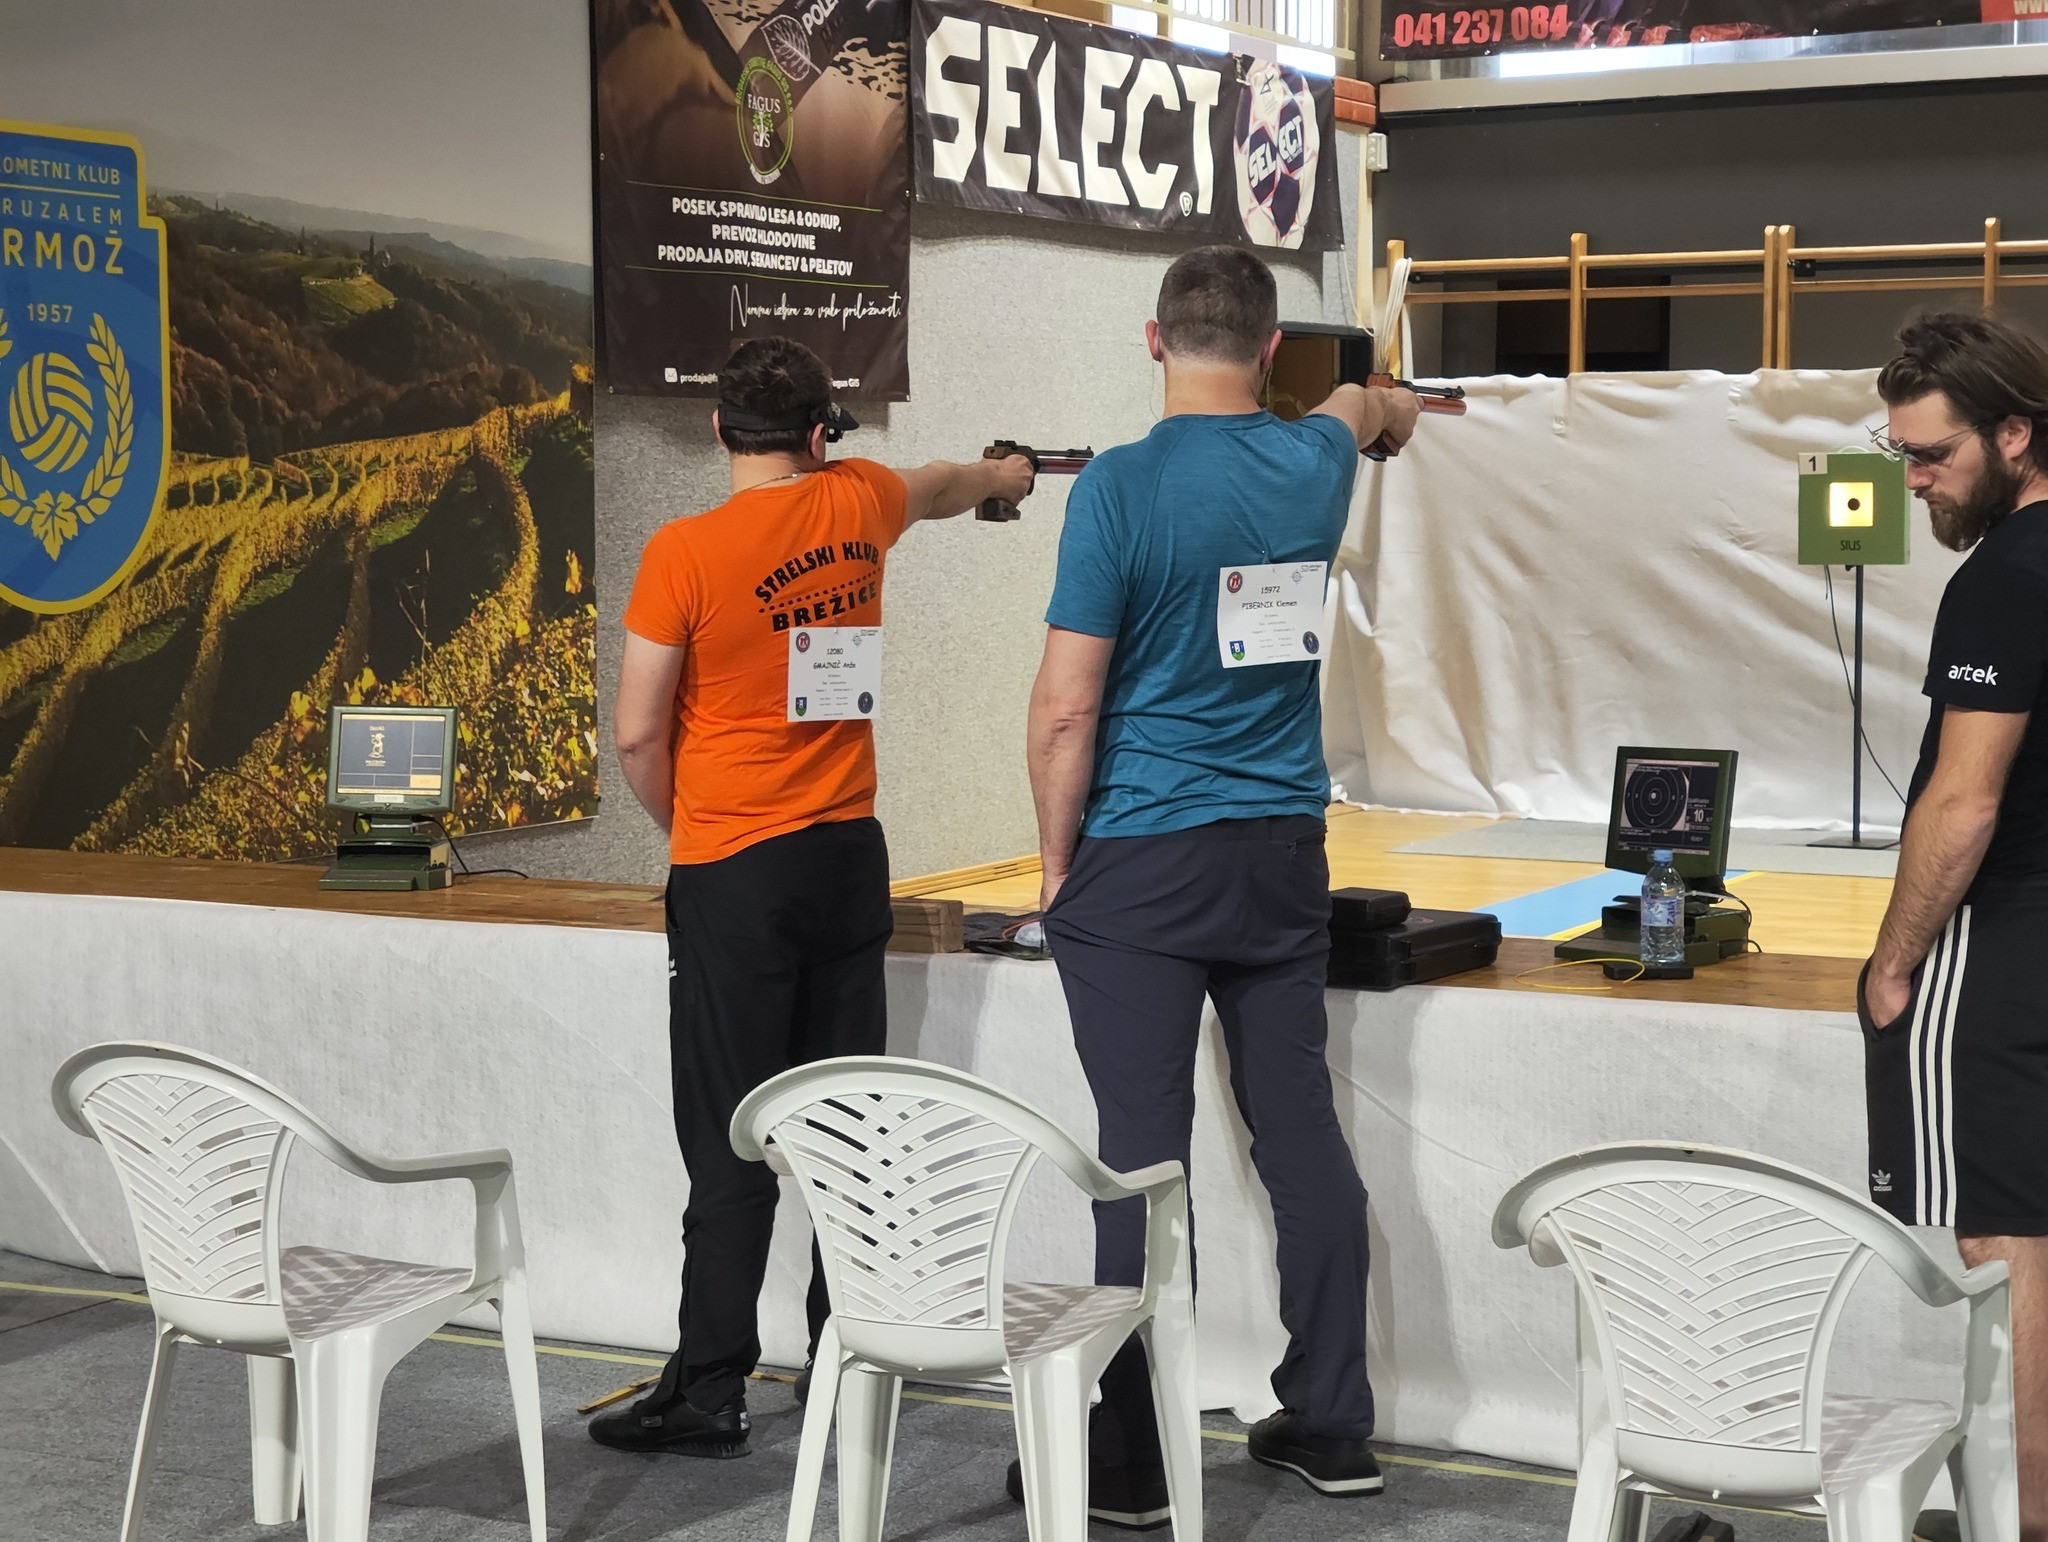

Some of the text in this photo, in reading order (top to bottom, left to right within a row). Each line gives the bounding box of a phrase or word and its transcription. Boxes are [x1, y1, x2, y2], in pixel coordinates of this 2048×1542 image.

[1394, 4, 1568, 47] 041 237 084
[747, 93, 781, 113] FAGUS
[926, 16, 1221, 215] SELECT
[0, 156, 120, 185] OMETNI KLUB
[3, 198, 122, 225] RUZALEM
[768, 207, 795, 225] LESA
[796, 210, 804, 226] &
[804, 211, 842, 233] ODKUP,
[712, 224, 816, 250] PREVOZ HLODOVINE
[3, 228, 124, 274] RMOŽ
[658, 244, 853, 276] PRODAJA DRV, SEKANCEV & PELETOV
[27, 303, 73, 323] 1957
[1808, 456, 1816, 471] 1
[1840, 540, 1861, 551] SIUS
[755, 542, 878, 603] STRELSKI KLUB
[1261, 586, 1280, 594] 15972
[772, 581, 877, 632] BREŽICE
[1242, 600, 1297, 610] PIBERNIK Klemen
[1948, 664, 1999, 686] artek
[1693, 808, 1705, 822] 10
